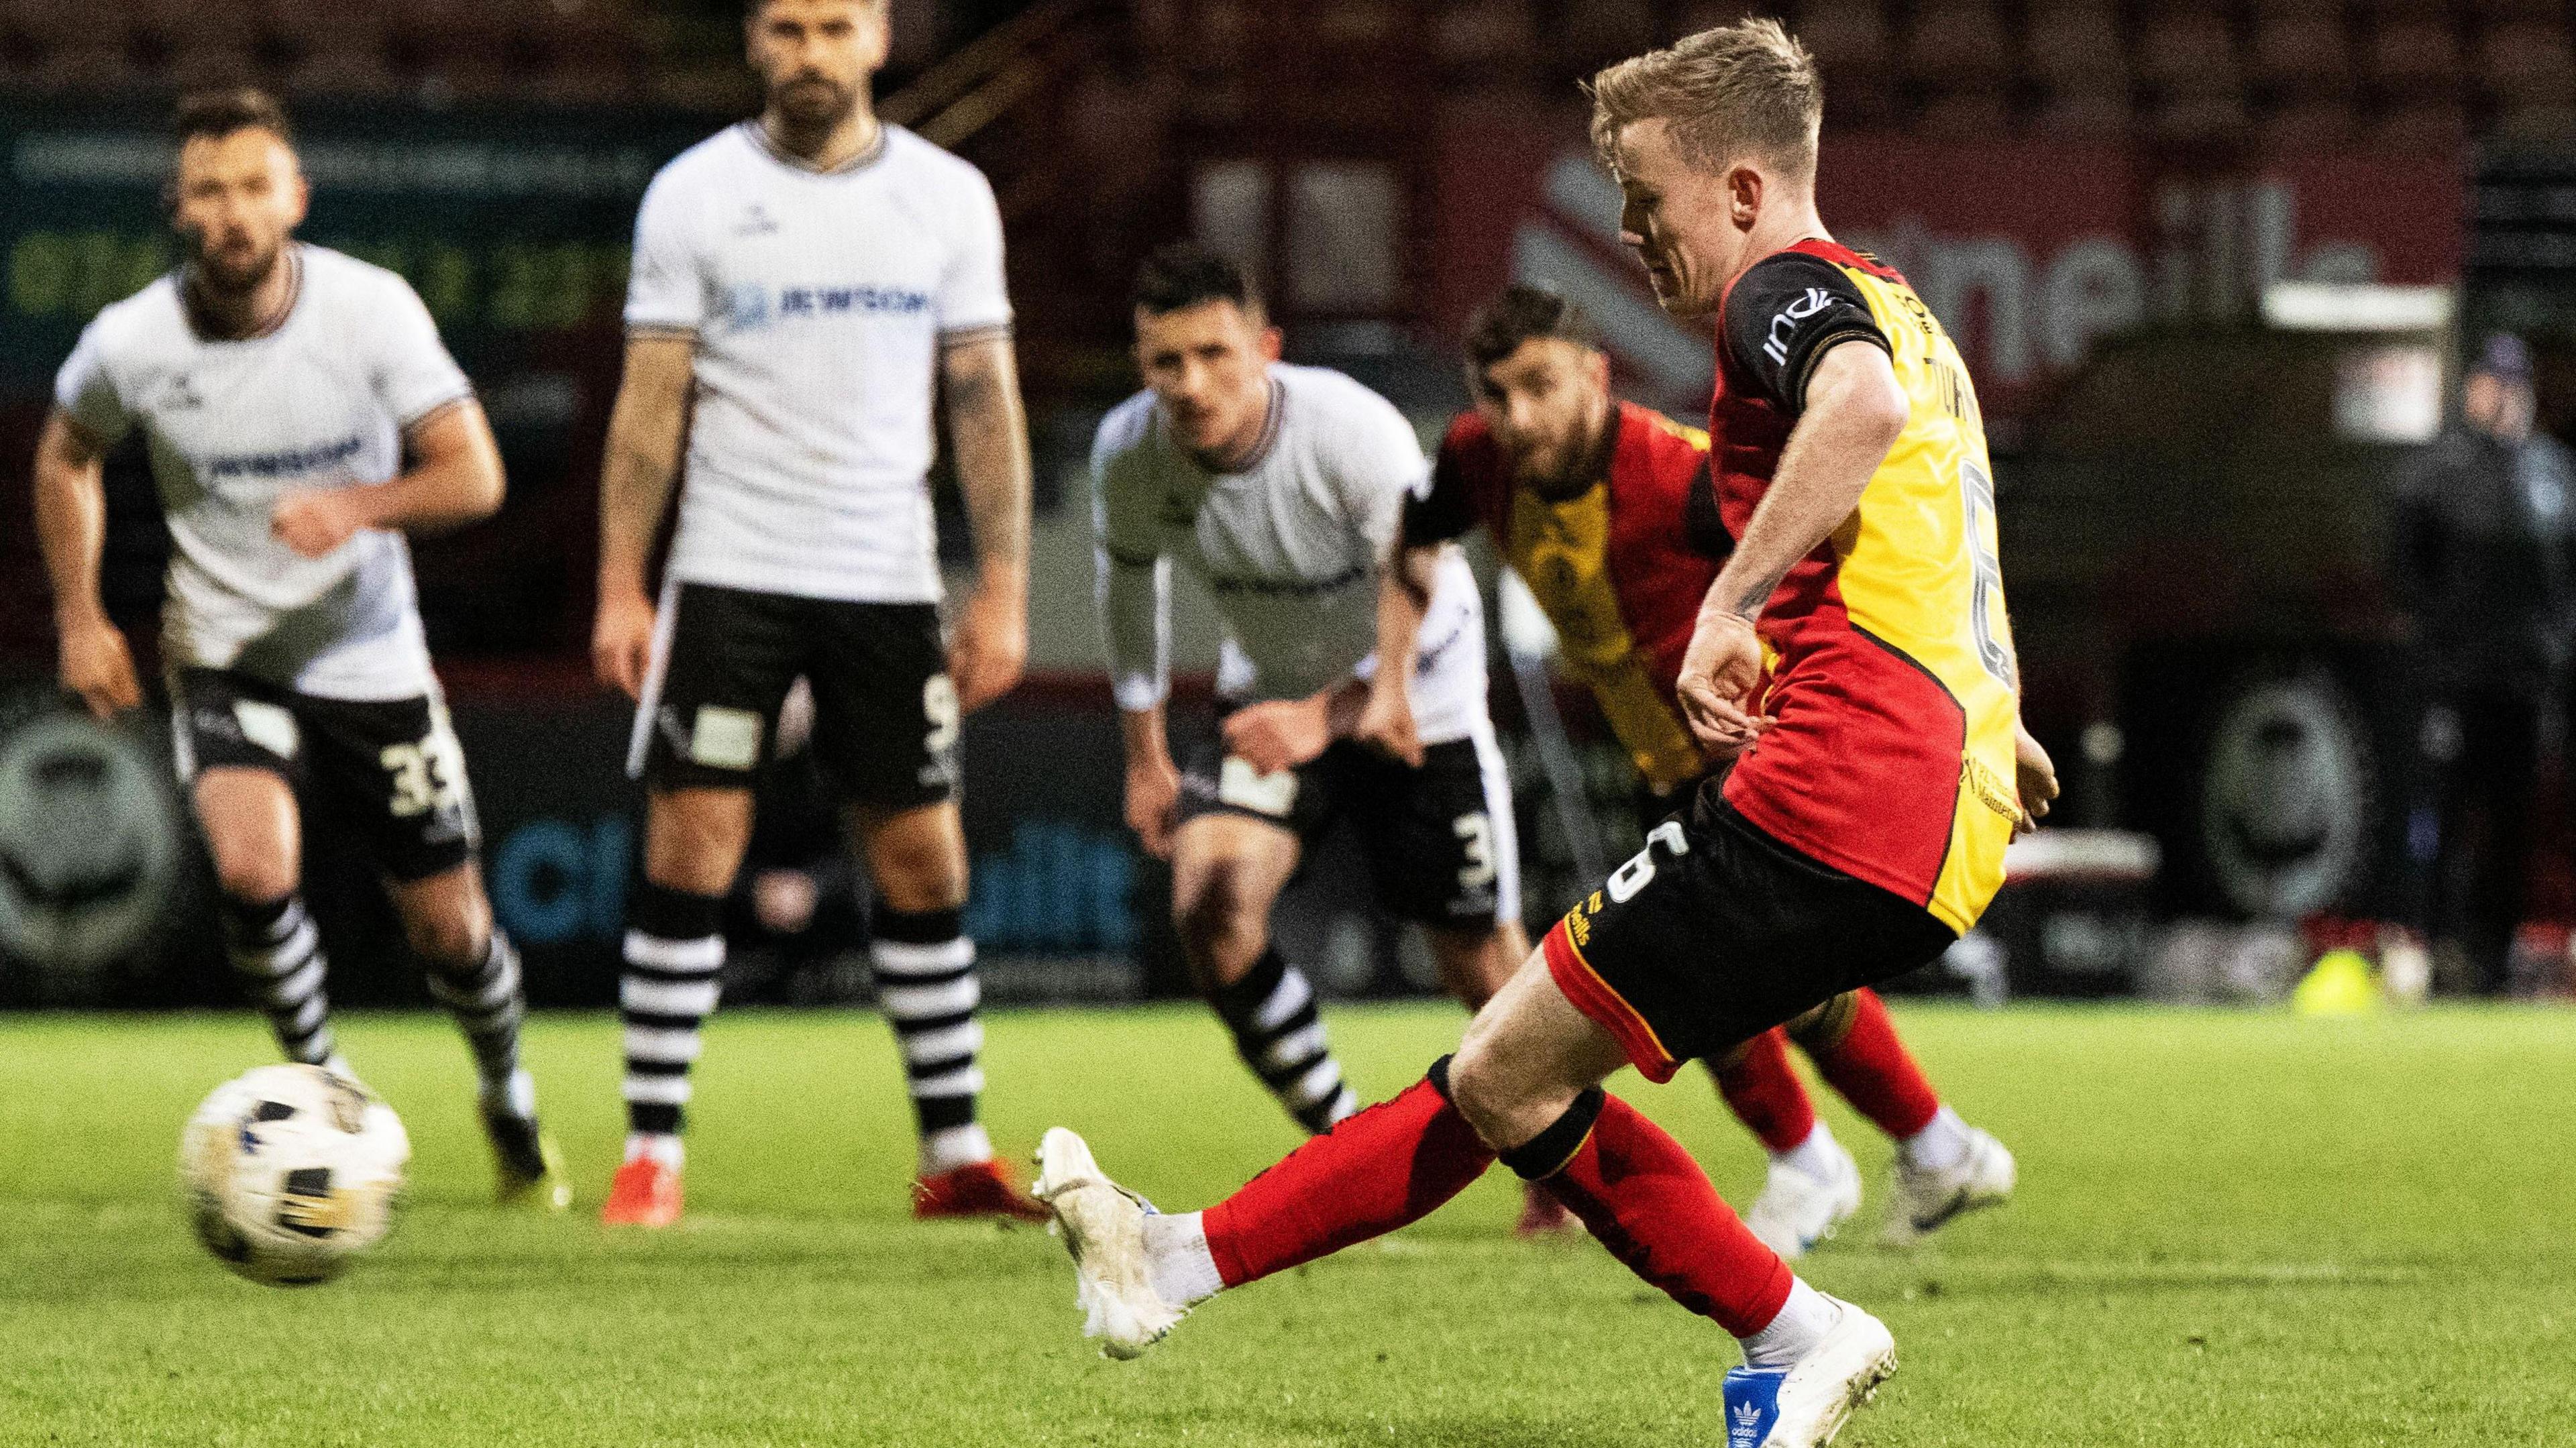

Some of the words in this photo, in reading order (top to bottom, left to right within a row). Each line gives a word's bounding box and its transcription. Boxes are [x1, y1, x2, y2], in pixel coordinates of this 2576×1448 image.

[923, 674, 960, 751] 9
[379, 740, 459, 818] 33
[1451, 812, 1495, 886] 3
[1607, 820, 1690, 903] 6
